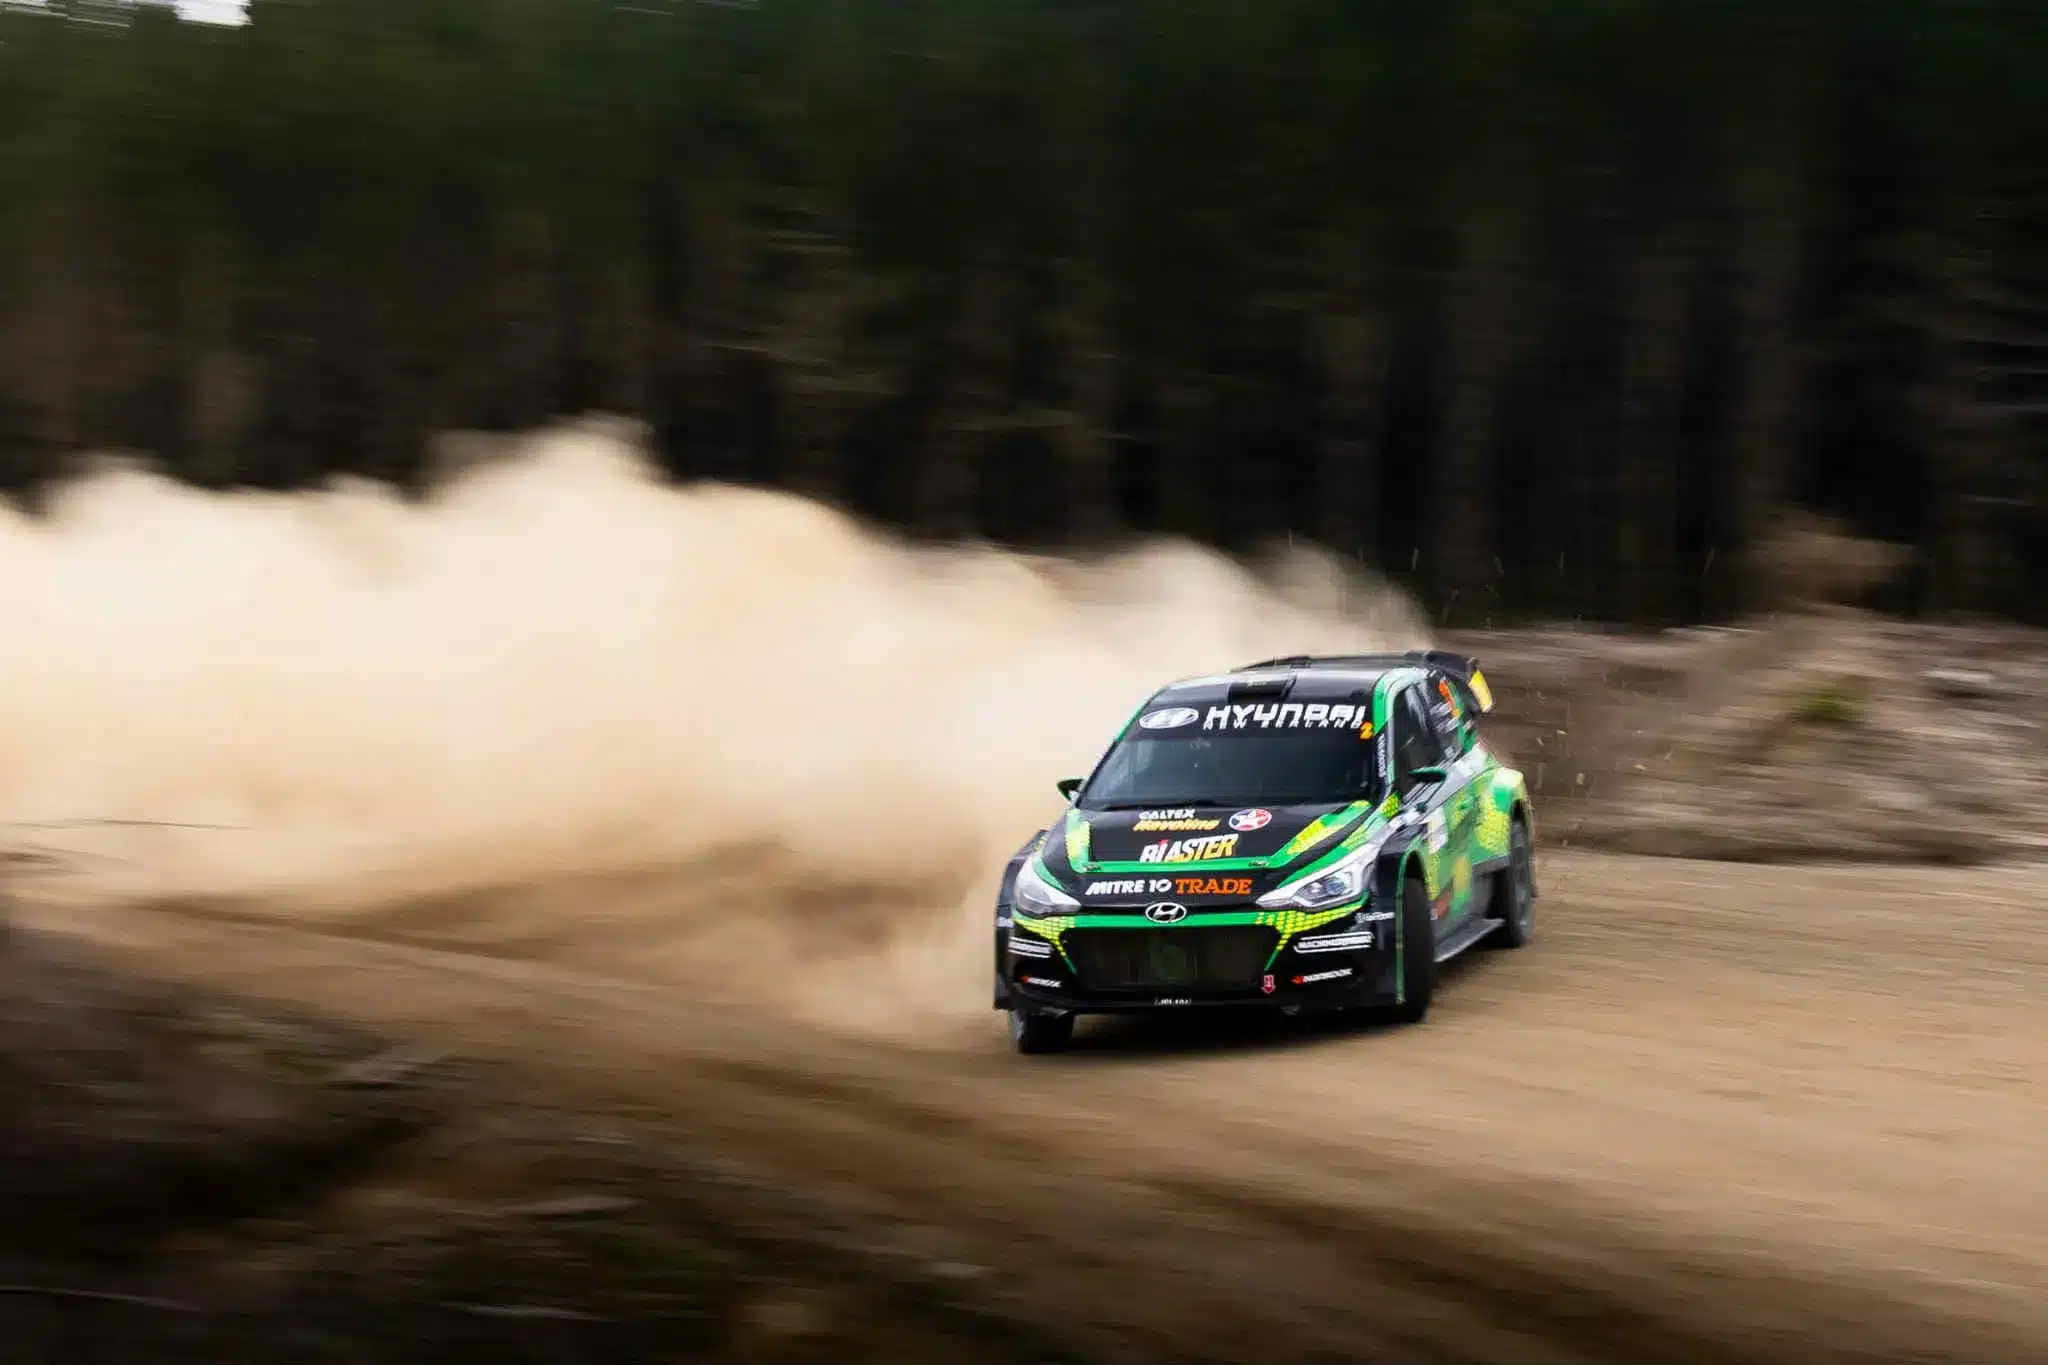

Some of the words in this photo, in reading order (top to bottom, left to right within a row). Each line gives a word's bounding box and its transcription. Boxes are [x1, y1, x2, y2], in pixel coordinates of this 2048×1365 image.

[1204, 703, 1367, 727] HYUNDAI
[1359, 721, 1374, 740] 2
[1138, 809, 1196, 821] CALTEX
[1085, 879, 1145, 896] MITRE
[1148, 878, 1172, 893] 10
[1175, 878, 1252, 895] TRADE
